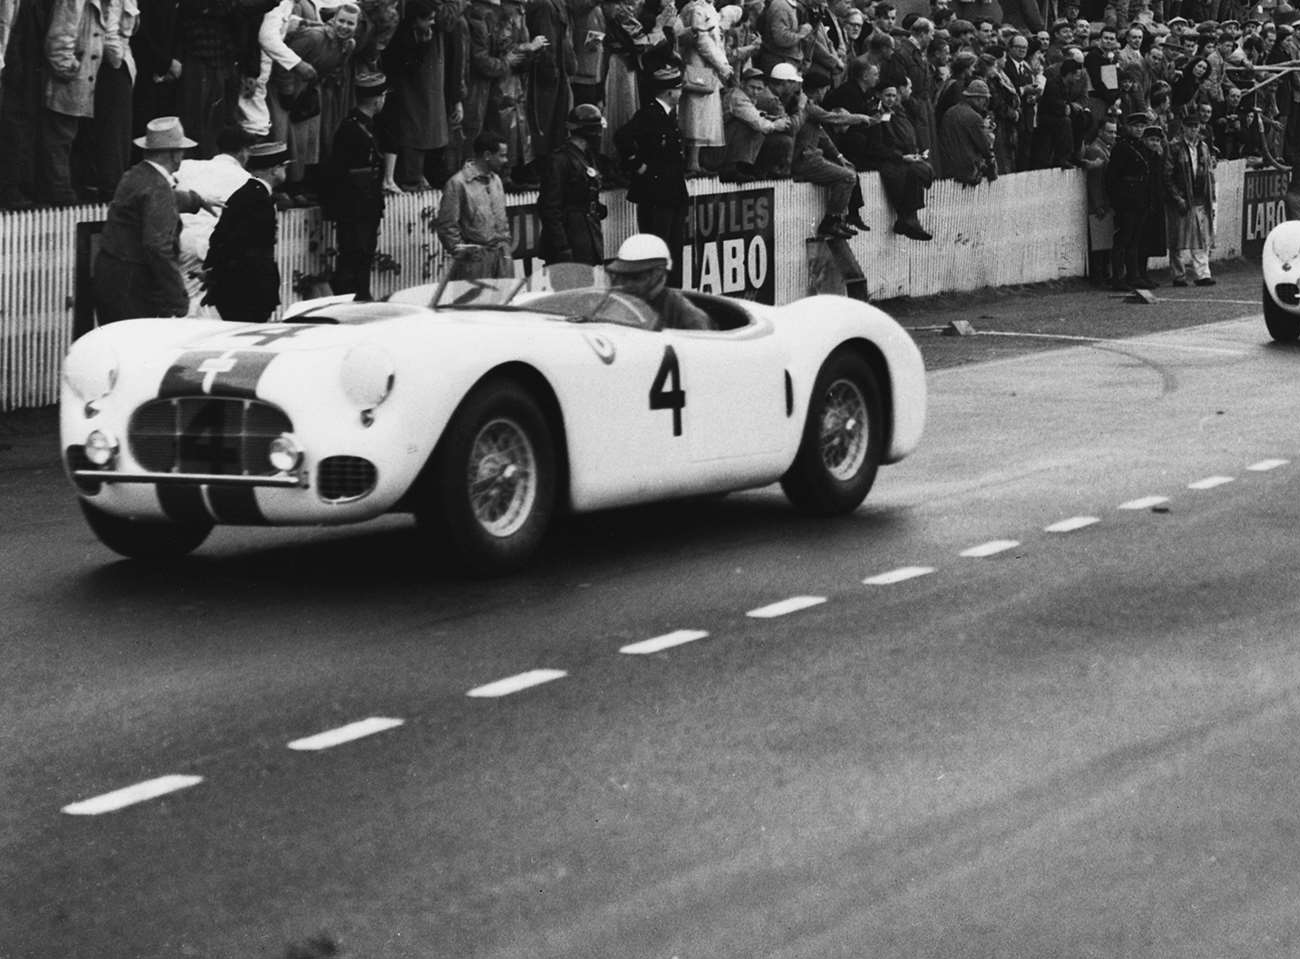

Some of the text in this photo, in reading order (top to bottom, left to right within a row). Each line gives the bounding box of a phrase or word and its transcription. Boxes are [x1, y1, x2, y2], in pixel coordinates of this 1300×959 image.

[1247, 173, 1289, 199] HUILES
[682, 235, 767, 296] LABO
[650, 344, 686, 437] 4
